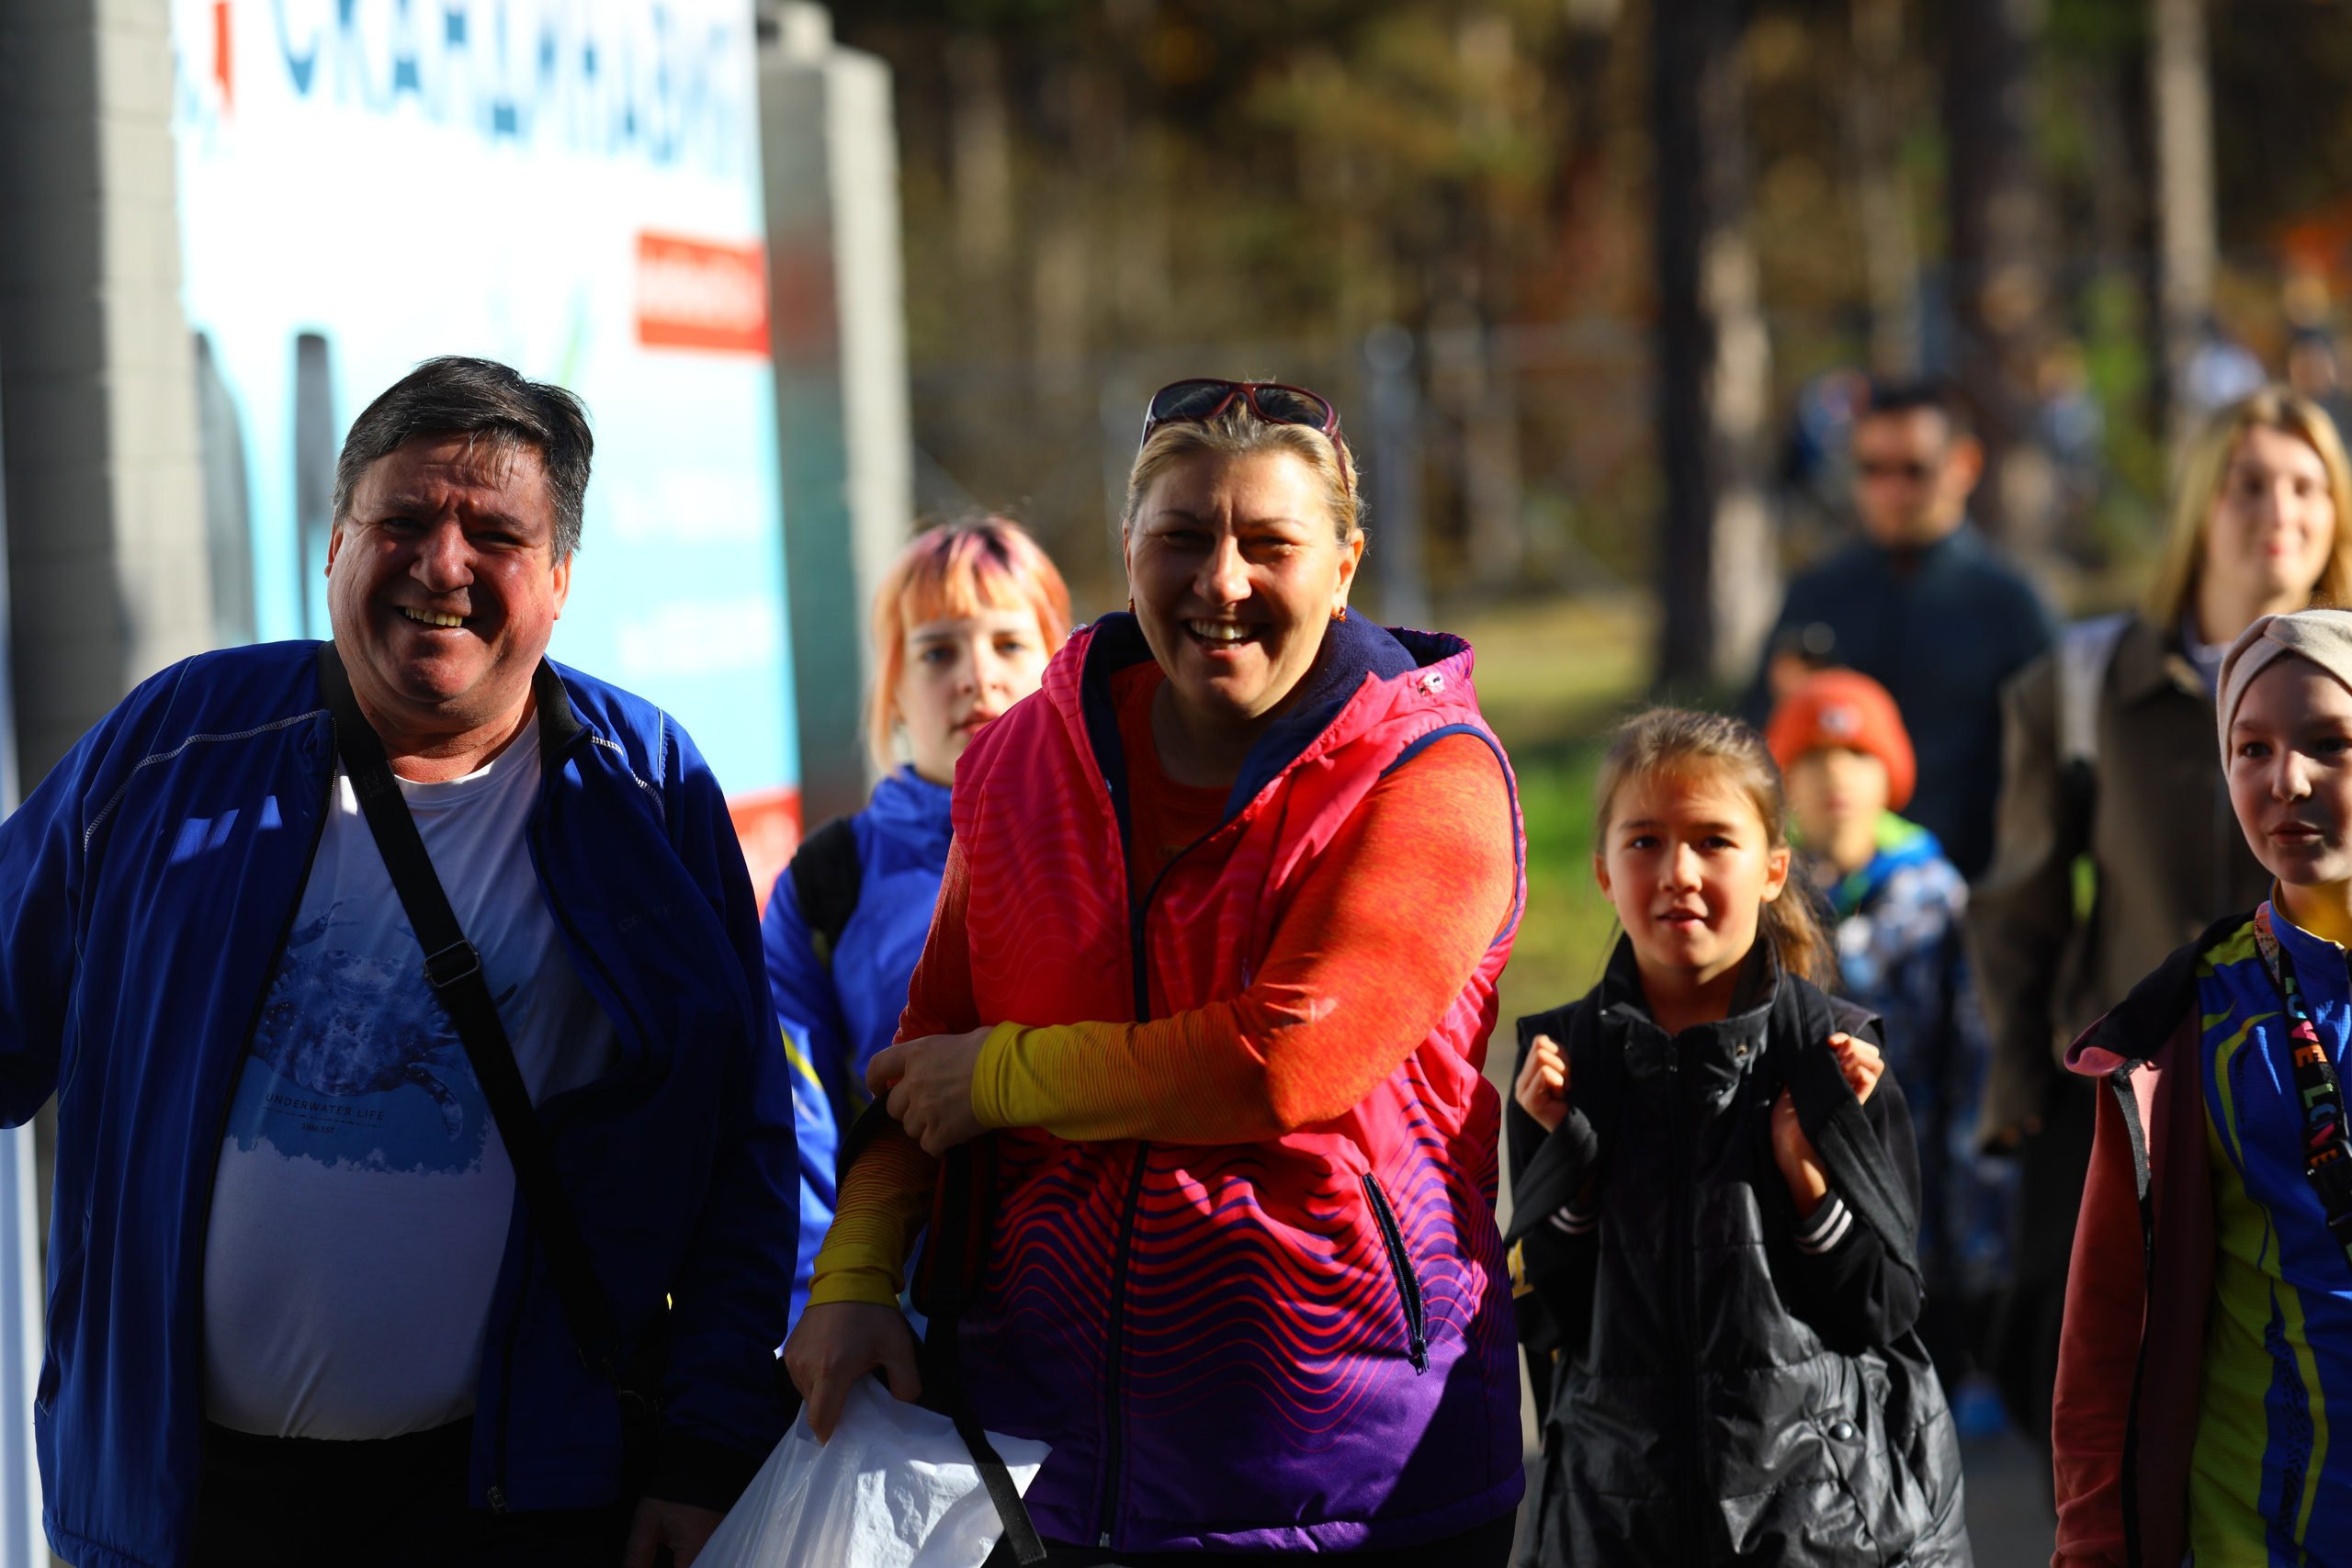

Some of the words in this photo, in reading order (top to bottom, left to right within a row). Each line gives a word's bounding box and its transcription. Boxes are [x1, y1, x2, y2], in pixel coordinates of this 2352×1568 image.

[266, 1093, 352, 1116] UNDERWATER
[357, 1109, 385, 1121] LIFE
[301, 1122, 320, 1133] 1986
